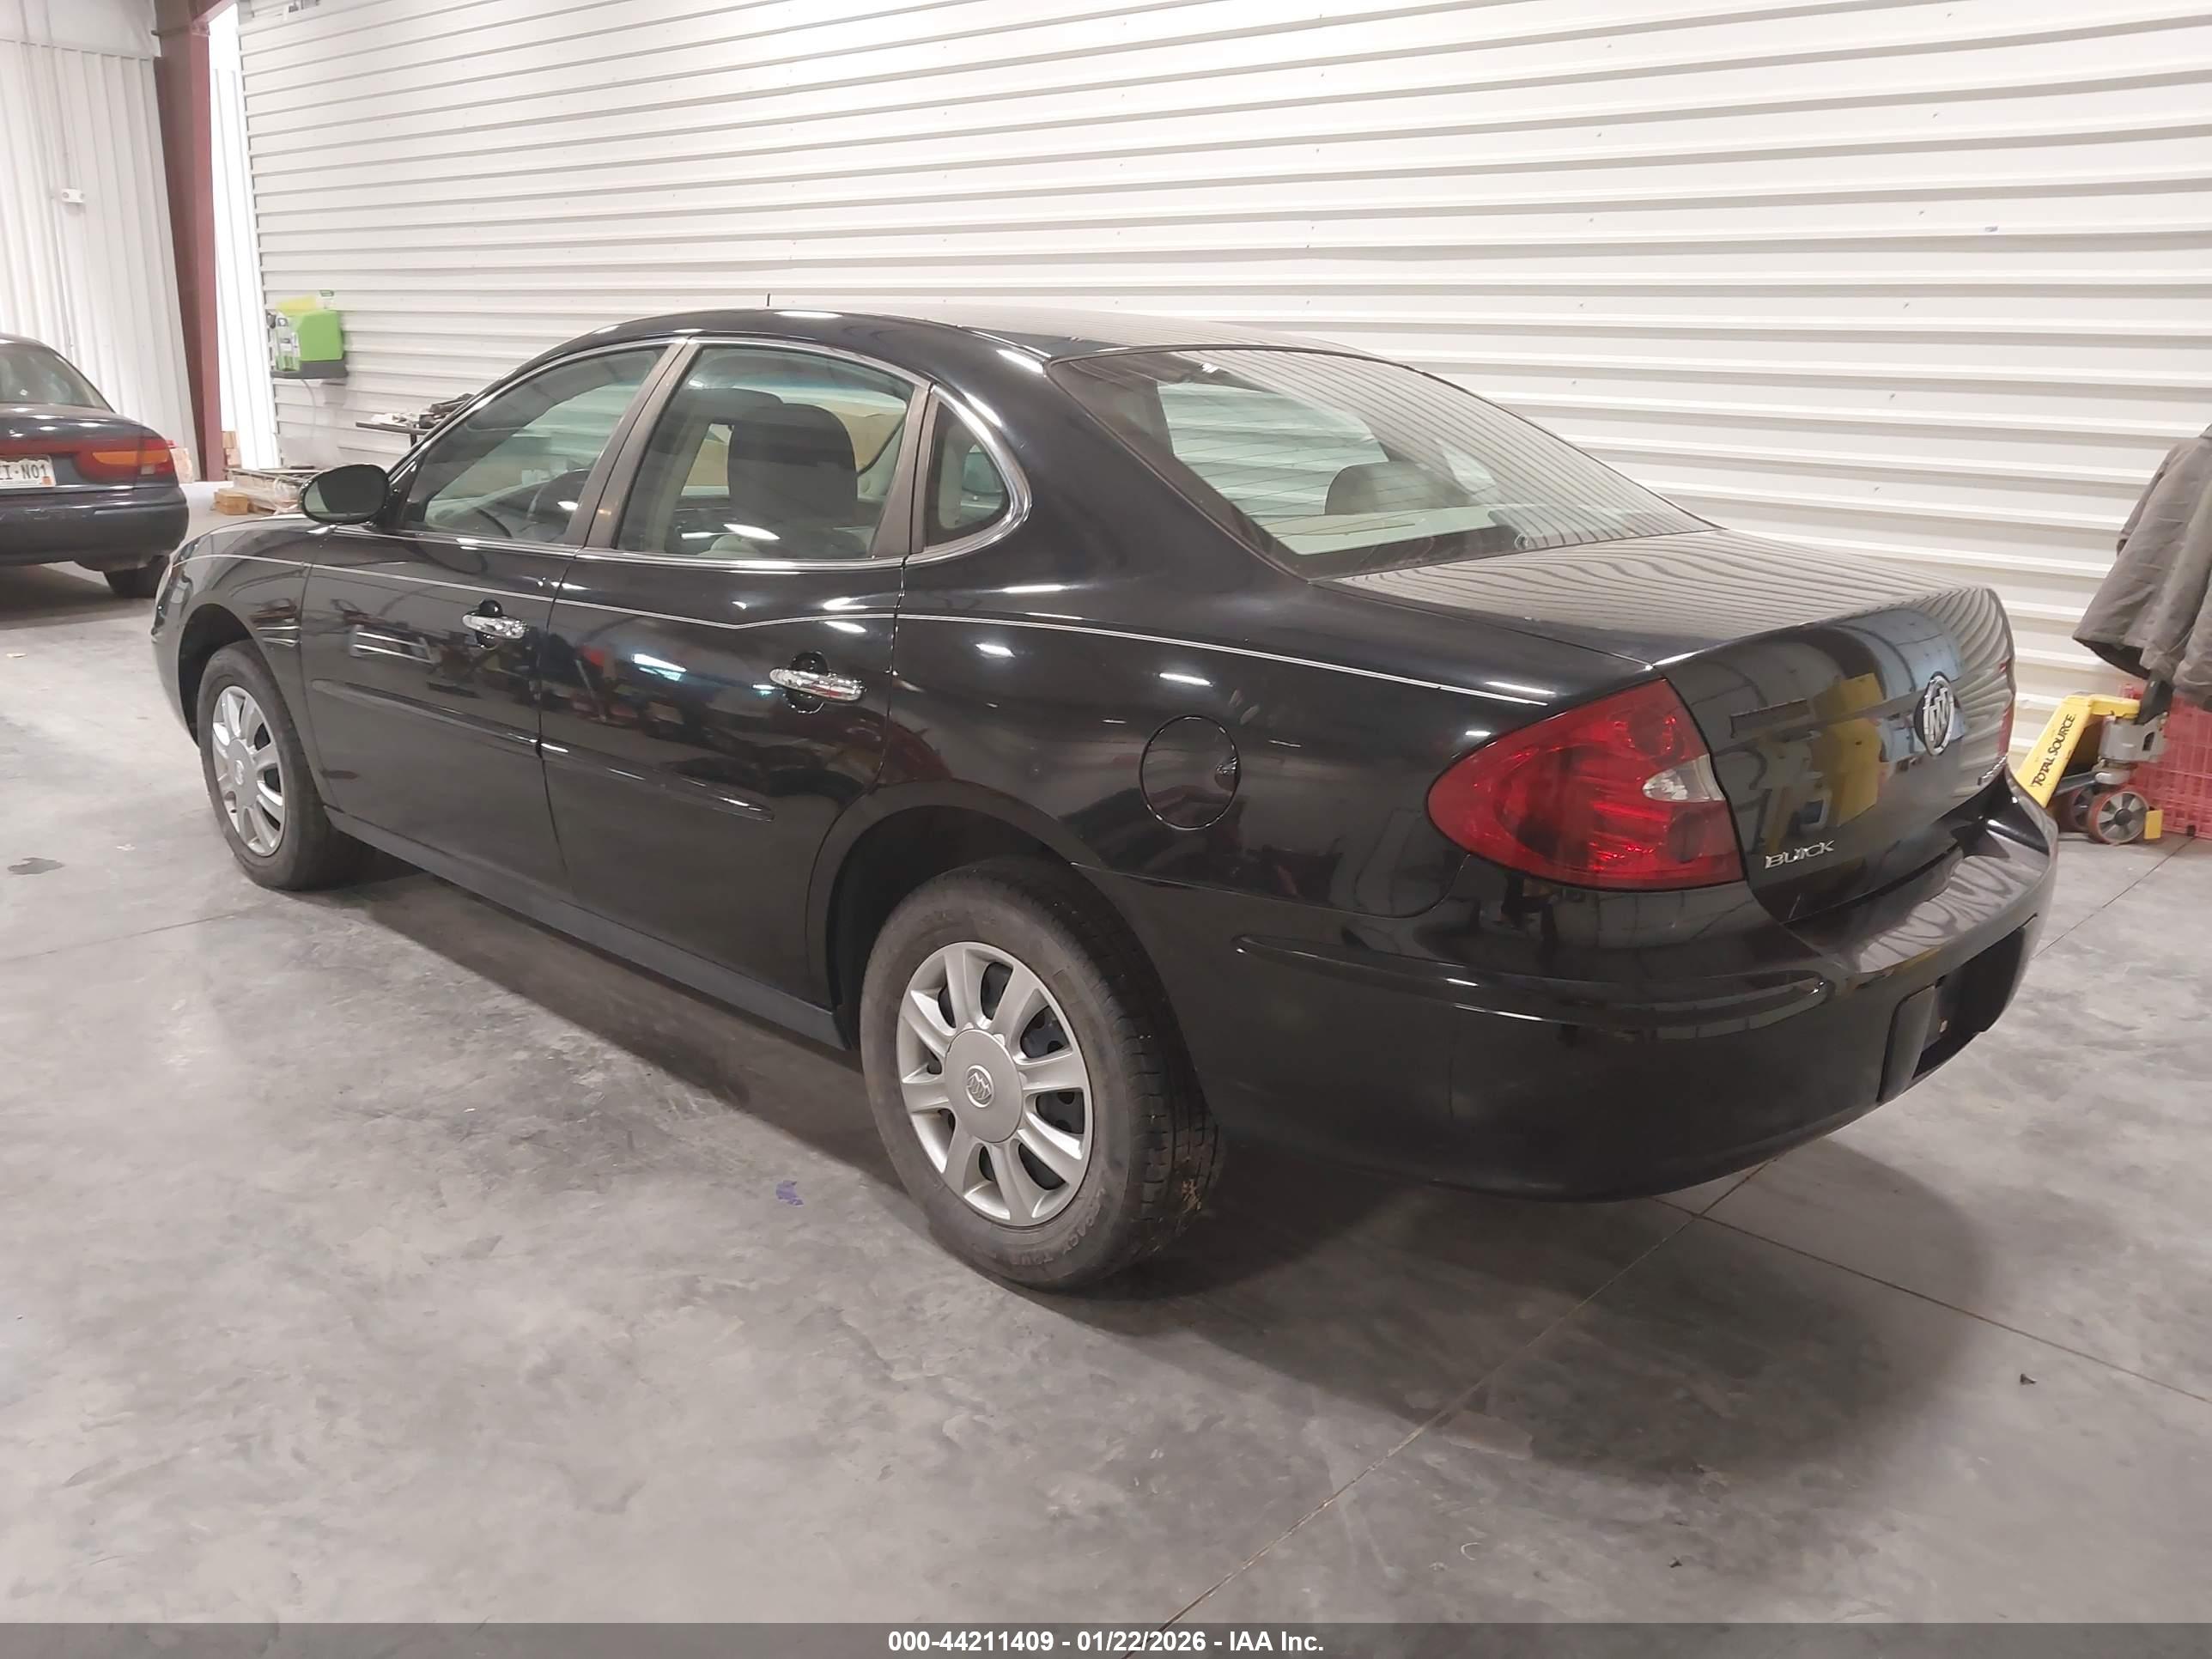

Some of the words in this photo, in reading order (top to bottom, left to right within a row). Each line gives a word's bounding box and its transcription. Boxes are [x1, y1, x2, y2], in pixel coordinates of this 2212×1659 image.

[2031, 757, 2055, 787] TOTAL
[2048, 714, 2075, 756] SOURCE
[1765, 840, 1835, 869] BUICK
